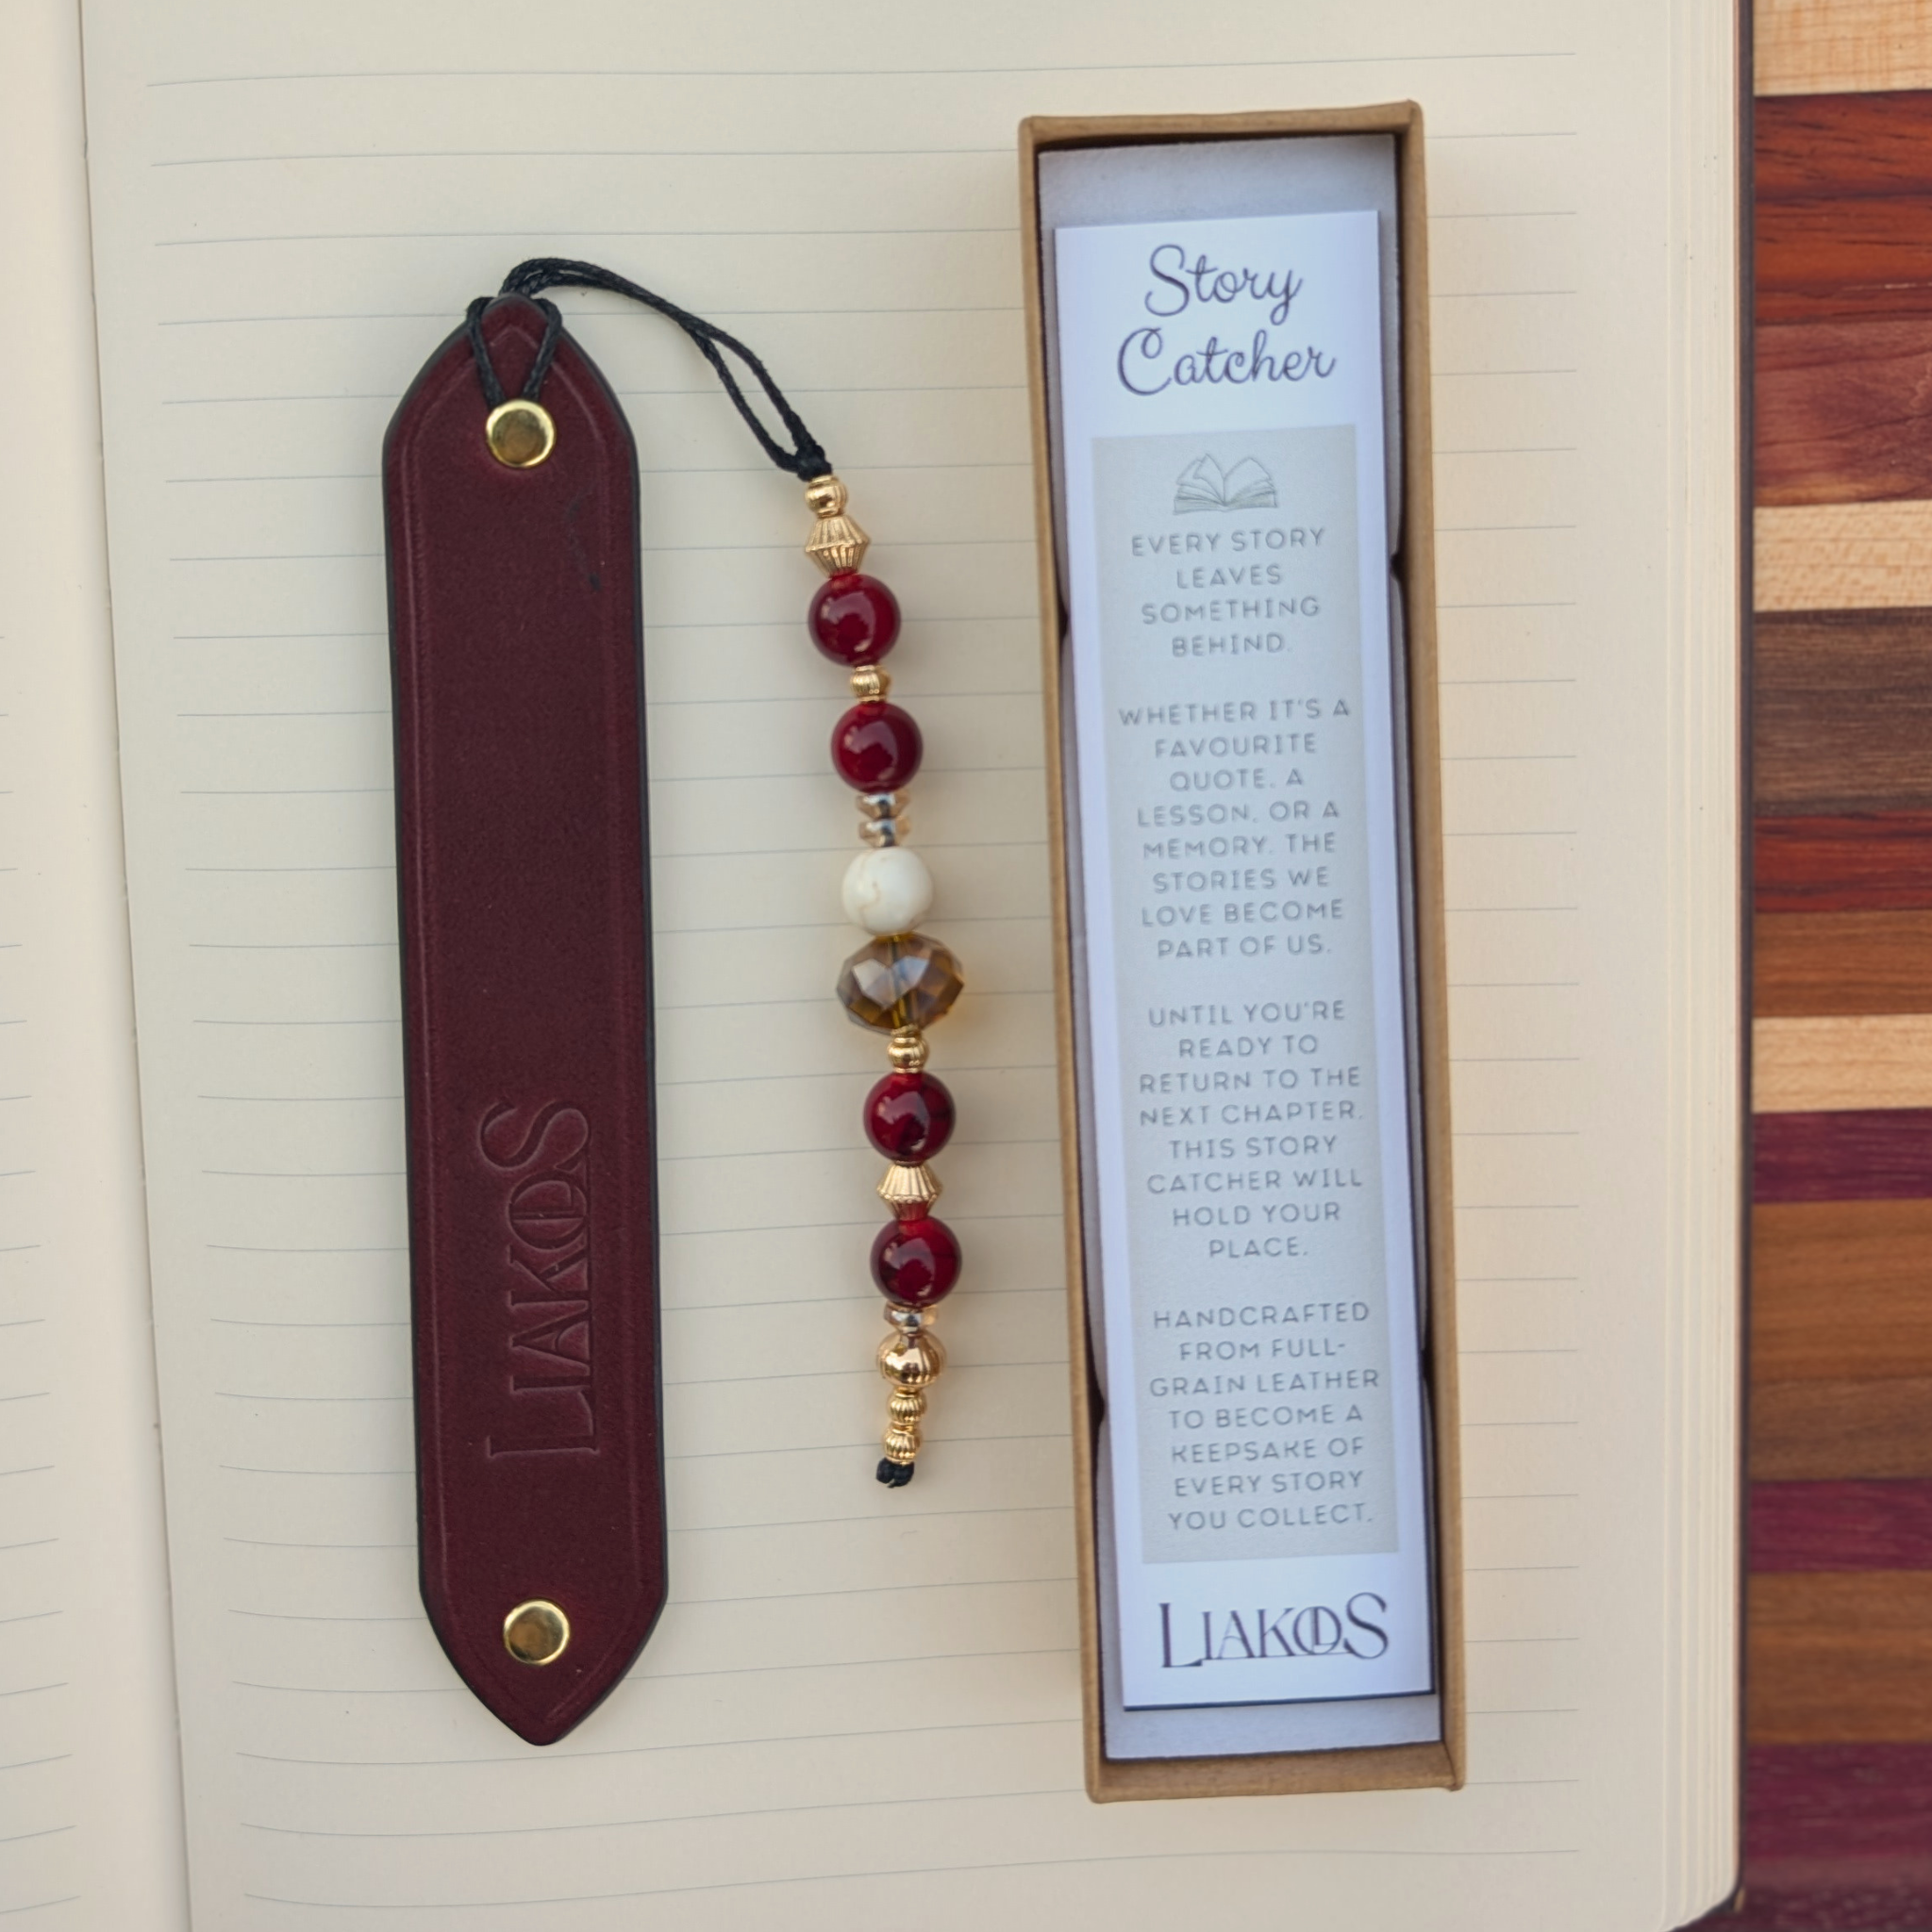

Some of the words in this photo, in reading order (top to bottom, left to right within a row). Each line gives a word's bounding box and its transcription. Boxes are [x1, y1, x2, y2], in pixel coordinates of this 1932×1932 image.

[1145, 244, 1303, 325] Story
[1117, 327, 1336, 396] Catcher
[1131, 533, 1220, 557] EVERY
[1231, 526, 1325, 552] STORY
[1176, 564, 1283, 589] LEAVES
[1141, 595, 1321, 625] SOMETHING
[1118, 701, 1257, 726] WHETHER
[1269, 698, 1322, 721] IT'S
[1332, 698, 1350, 717] A
[1155, 733, 1317, 758] FAVOURITE
[1286, 768, 1304, 786] A
[1269, 800, 1309, 823] OR
[1322, 800, 1340, 819] A
[1286, 832, 1336, 854] THE
[1152, 868, 1276, 893] STORIES
[1288, 866, 1329, 887] WE
[1141, 903, 1211, 928] LOVE
[1224, 898, 1344, 925] BECOME
[1158, 937, 1229, 958] PART
[1239, 935, 1275, 957] OF
[1287, 933, 1332, 956] US.
[1149, 1004, 1232, 1027] UNTIL
[1243, 999, 1346, 1024] YOU'RE
[1178, 1036, 1273, 1059] READY
[1283, 1034, 1317, 1057] TO
[1139, 1071, 1251, 1093] RETURN
[1263, 1069, 1298, 1090] TO
[1309, 1066, 1360, 1087] THE
[1140, 1106, 1209, 1126] NEXT
[1169, 1138, 1236, 1159] THIS
[1245, 1135, 1338, 1157] STORY
[1147, 1169, 1281, 1194] CATCHER
[1293, 1166, 1363, 1189] WILL
[1173, 1205, 1251, 1227] HOLD
[1263, 1201, 1341, 1224] YOUR
[1208, 1236, 1308, 1259] PLACE.
[1153, 1302, 1370, 1328] HANDCRAFTED
[1179, 1341, 1260, 1361] FROM
[1272, 1338, 1346, 1358] FULL-
[1149, 1374, 1245, 1397] GRAIN
[1257, 1369, 1379, 1393] LEATHER
[1169, 1409, 1204, 1429] TO
[1215, 1404, 1335, 1428] BECOME
[1346, 1405, 1363, 1422] A
[1171, 1439, 1316, 1463] KEEPSAKE
[1327, 1437, 1364, 1457] OF
[1174, 1474, 1261, 1497] EVERY
[1272, 1470, 1364, 1493] STORY
[1168, 1510, 1226, 1530] YOU
[1237, 1503, 1374, 1528] COLLECT.
